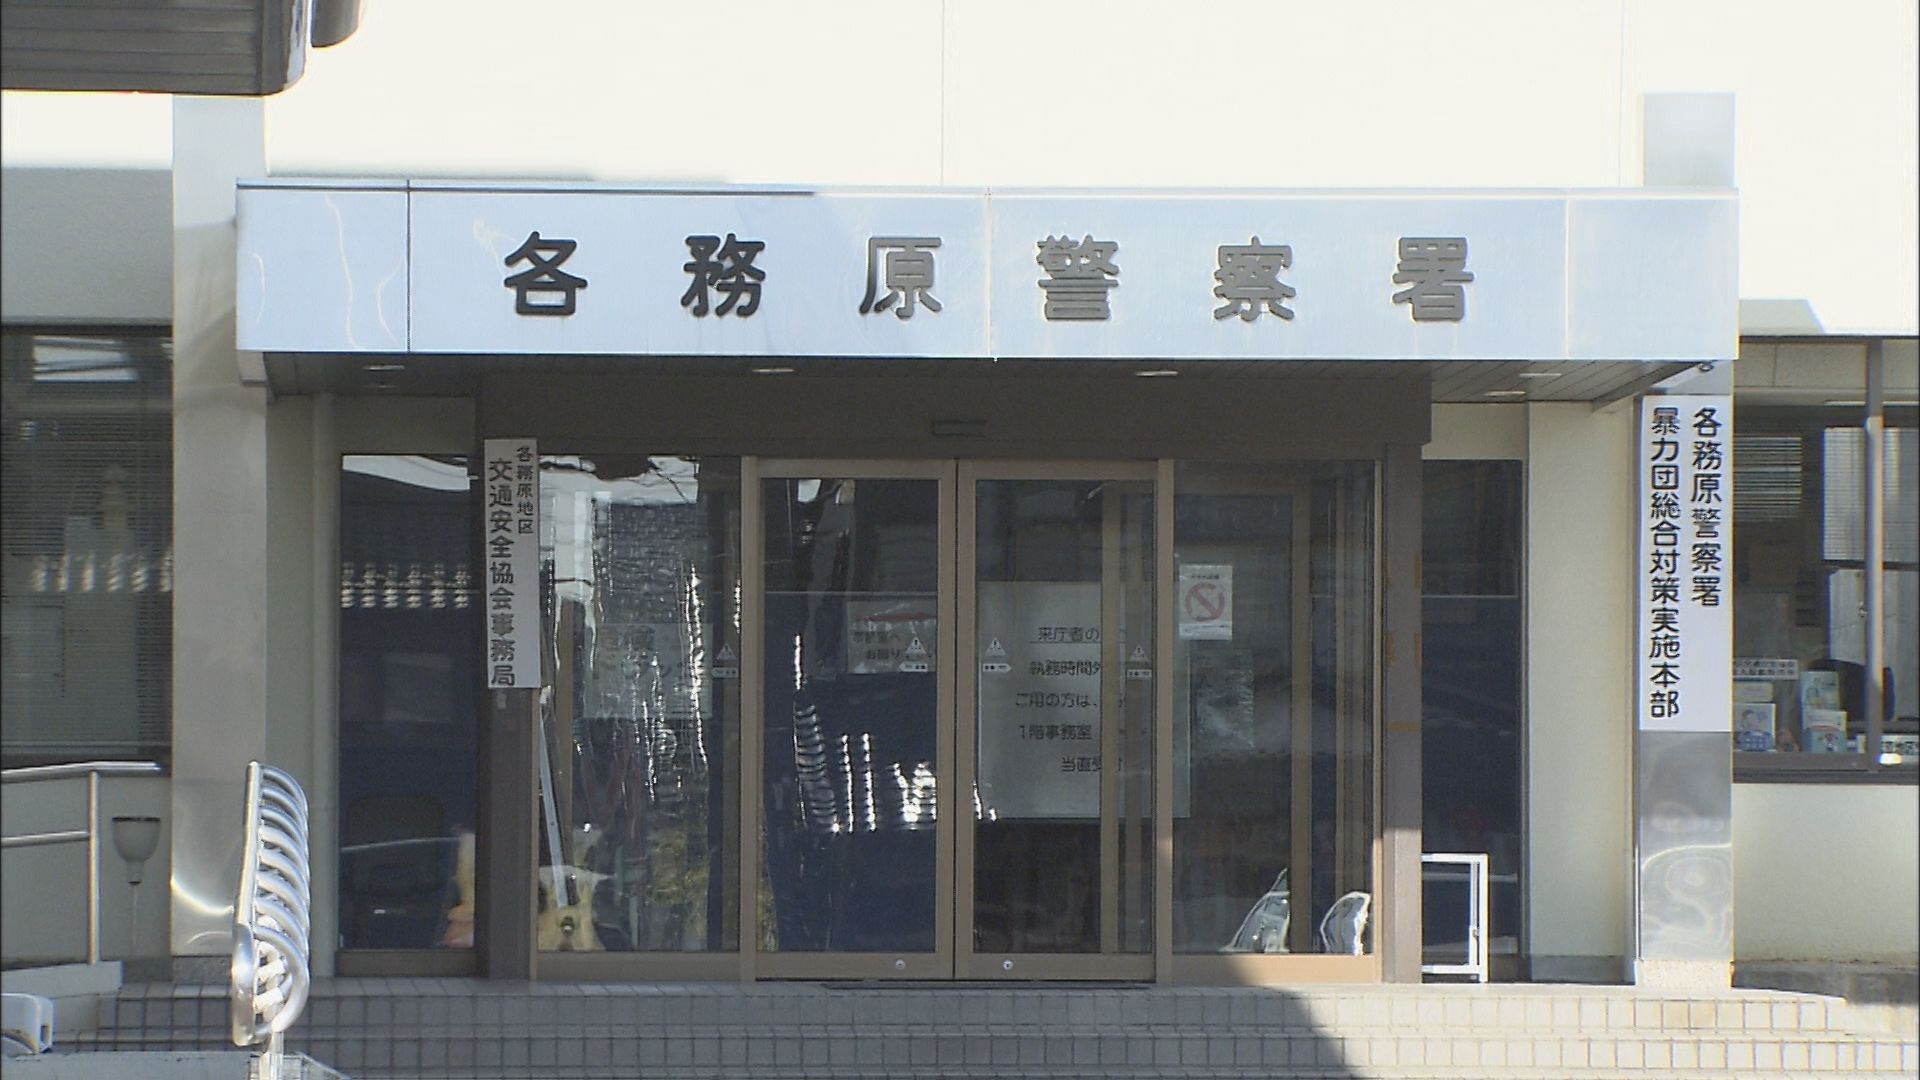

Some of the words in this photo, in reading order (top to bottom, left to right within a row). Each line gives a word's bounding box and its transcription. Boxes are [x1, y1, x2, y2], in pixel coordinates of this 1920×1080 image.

[503, 230, 1475, 324] 各務原警察署
[488, 457, 516, 687] 交通安全協会事務局
[515, 446, 535, 535] 各務原地区
[1648, 406, 1682, 719] 暴力団総合対策実施本部
[1690, 406, 1723, 608] 各務原警察署
